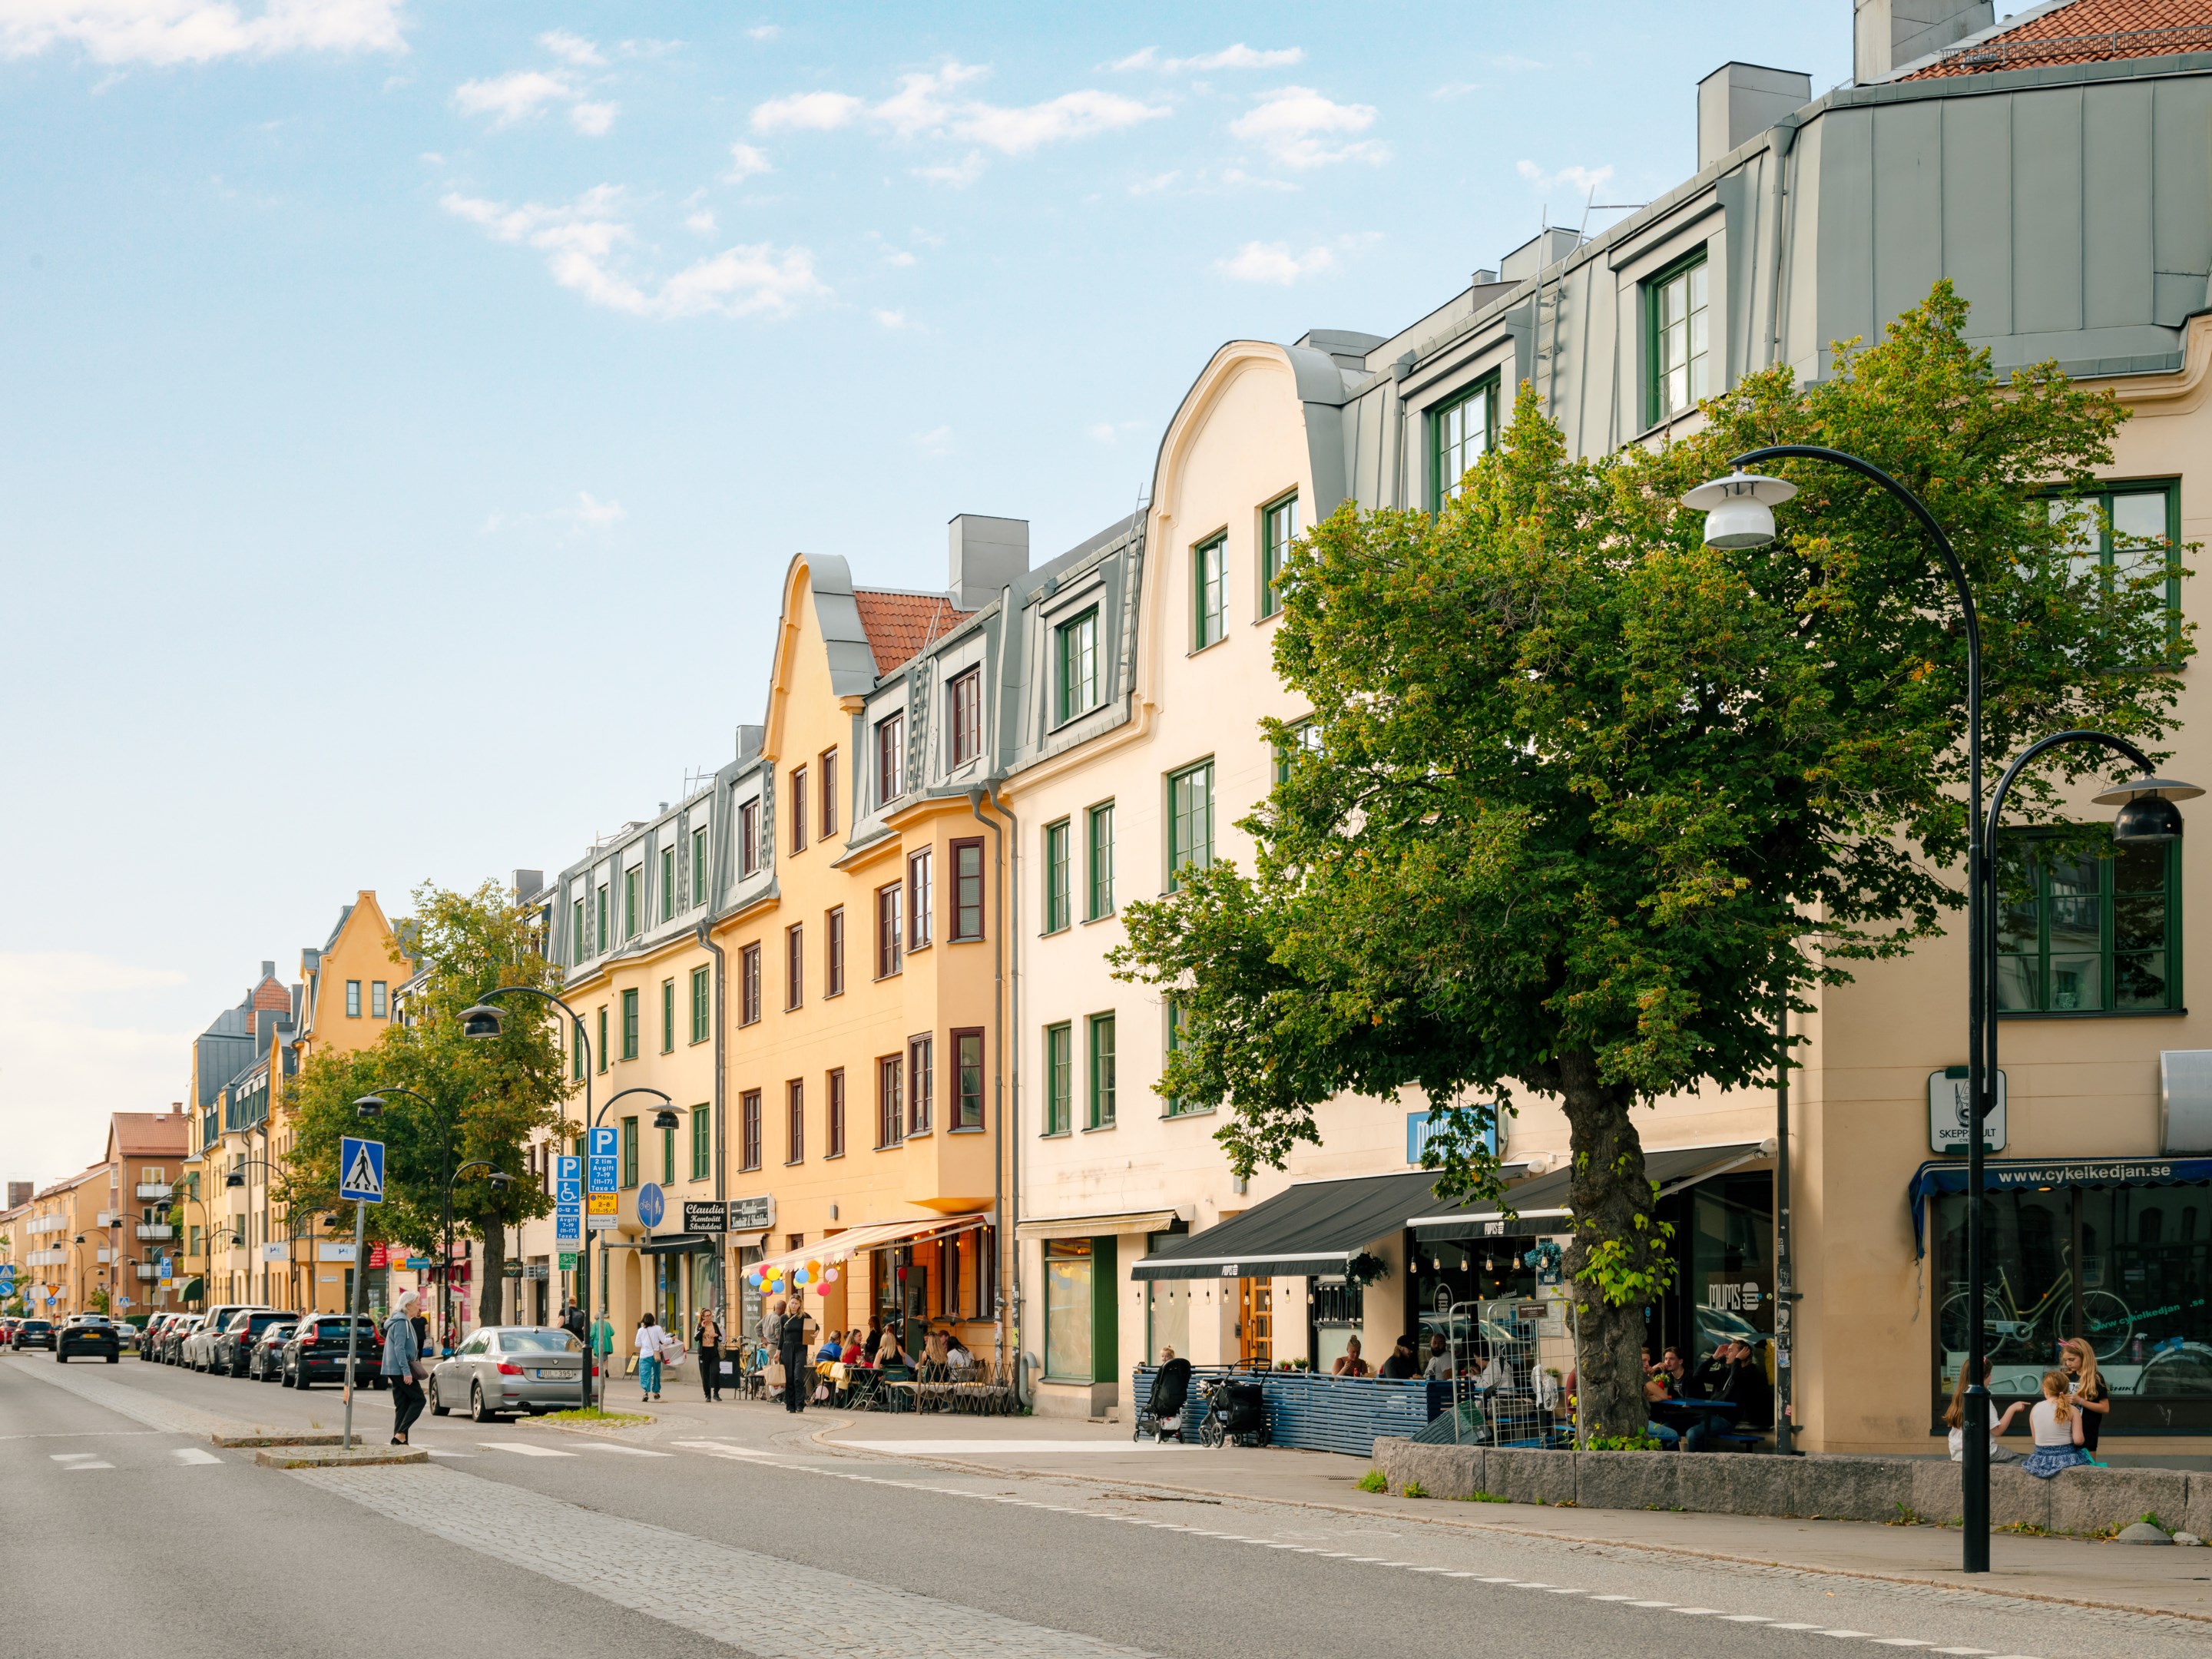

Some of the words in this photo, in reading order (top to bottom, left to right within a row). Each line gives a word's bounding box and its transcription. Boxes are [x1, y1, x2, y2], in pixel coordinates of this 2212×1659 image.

[597, 1131, 613, 1154] P
[1939, 1129, 1996, 1138] SKEPPULT
[563, 1158, 577, 1177] P
[1998, 1165, 2171, 1184] www.cykelkedjan.se
[686, 1204, 725, 1214] Claudia
[1709, 1284, 1740, 1310] MUMS
